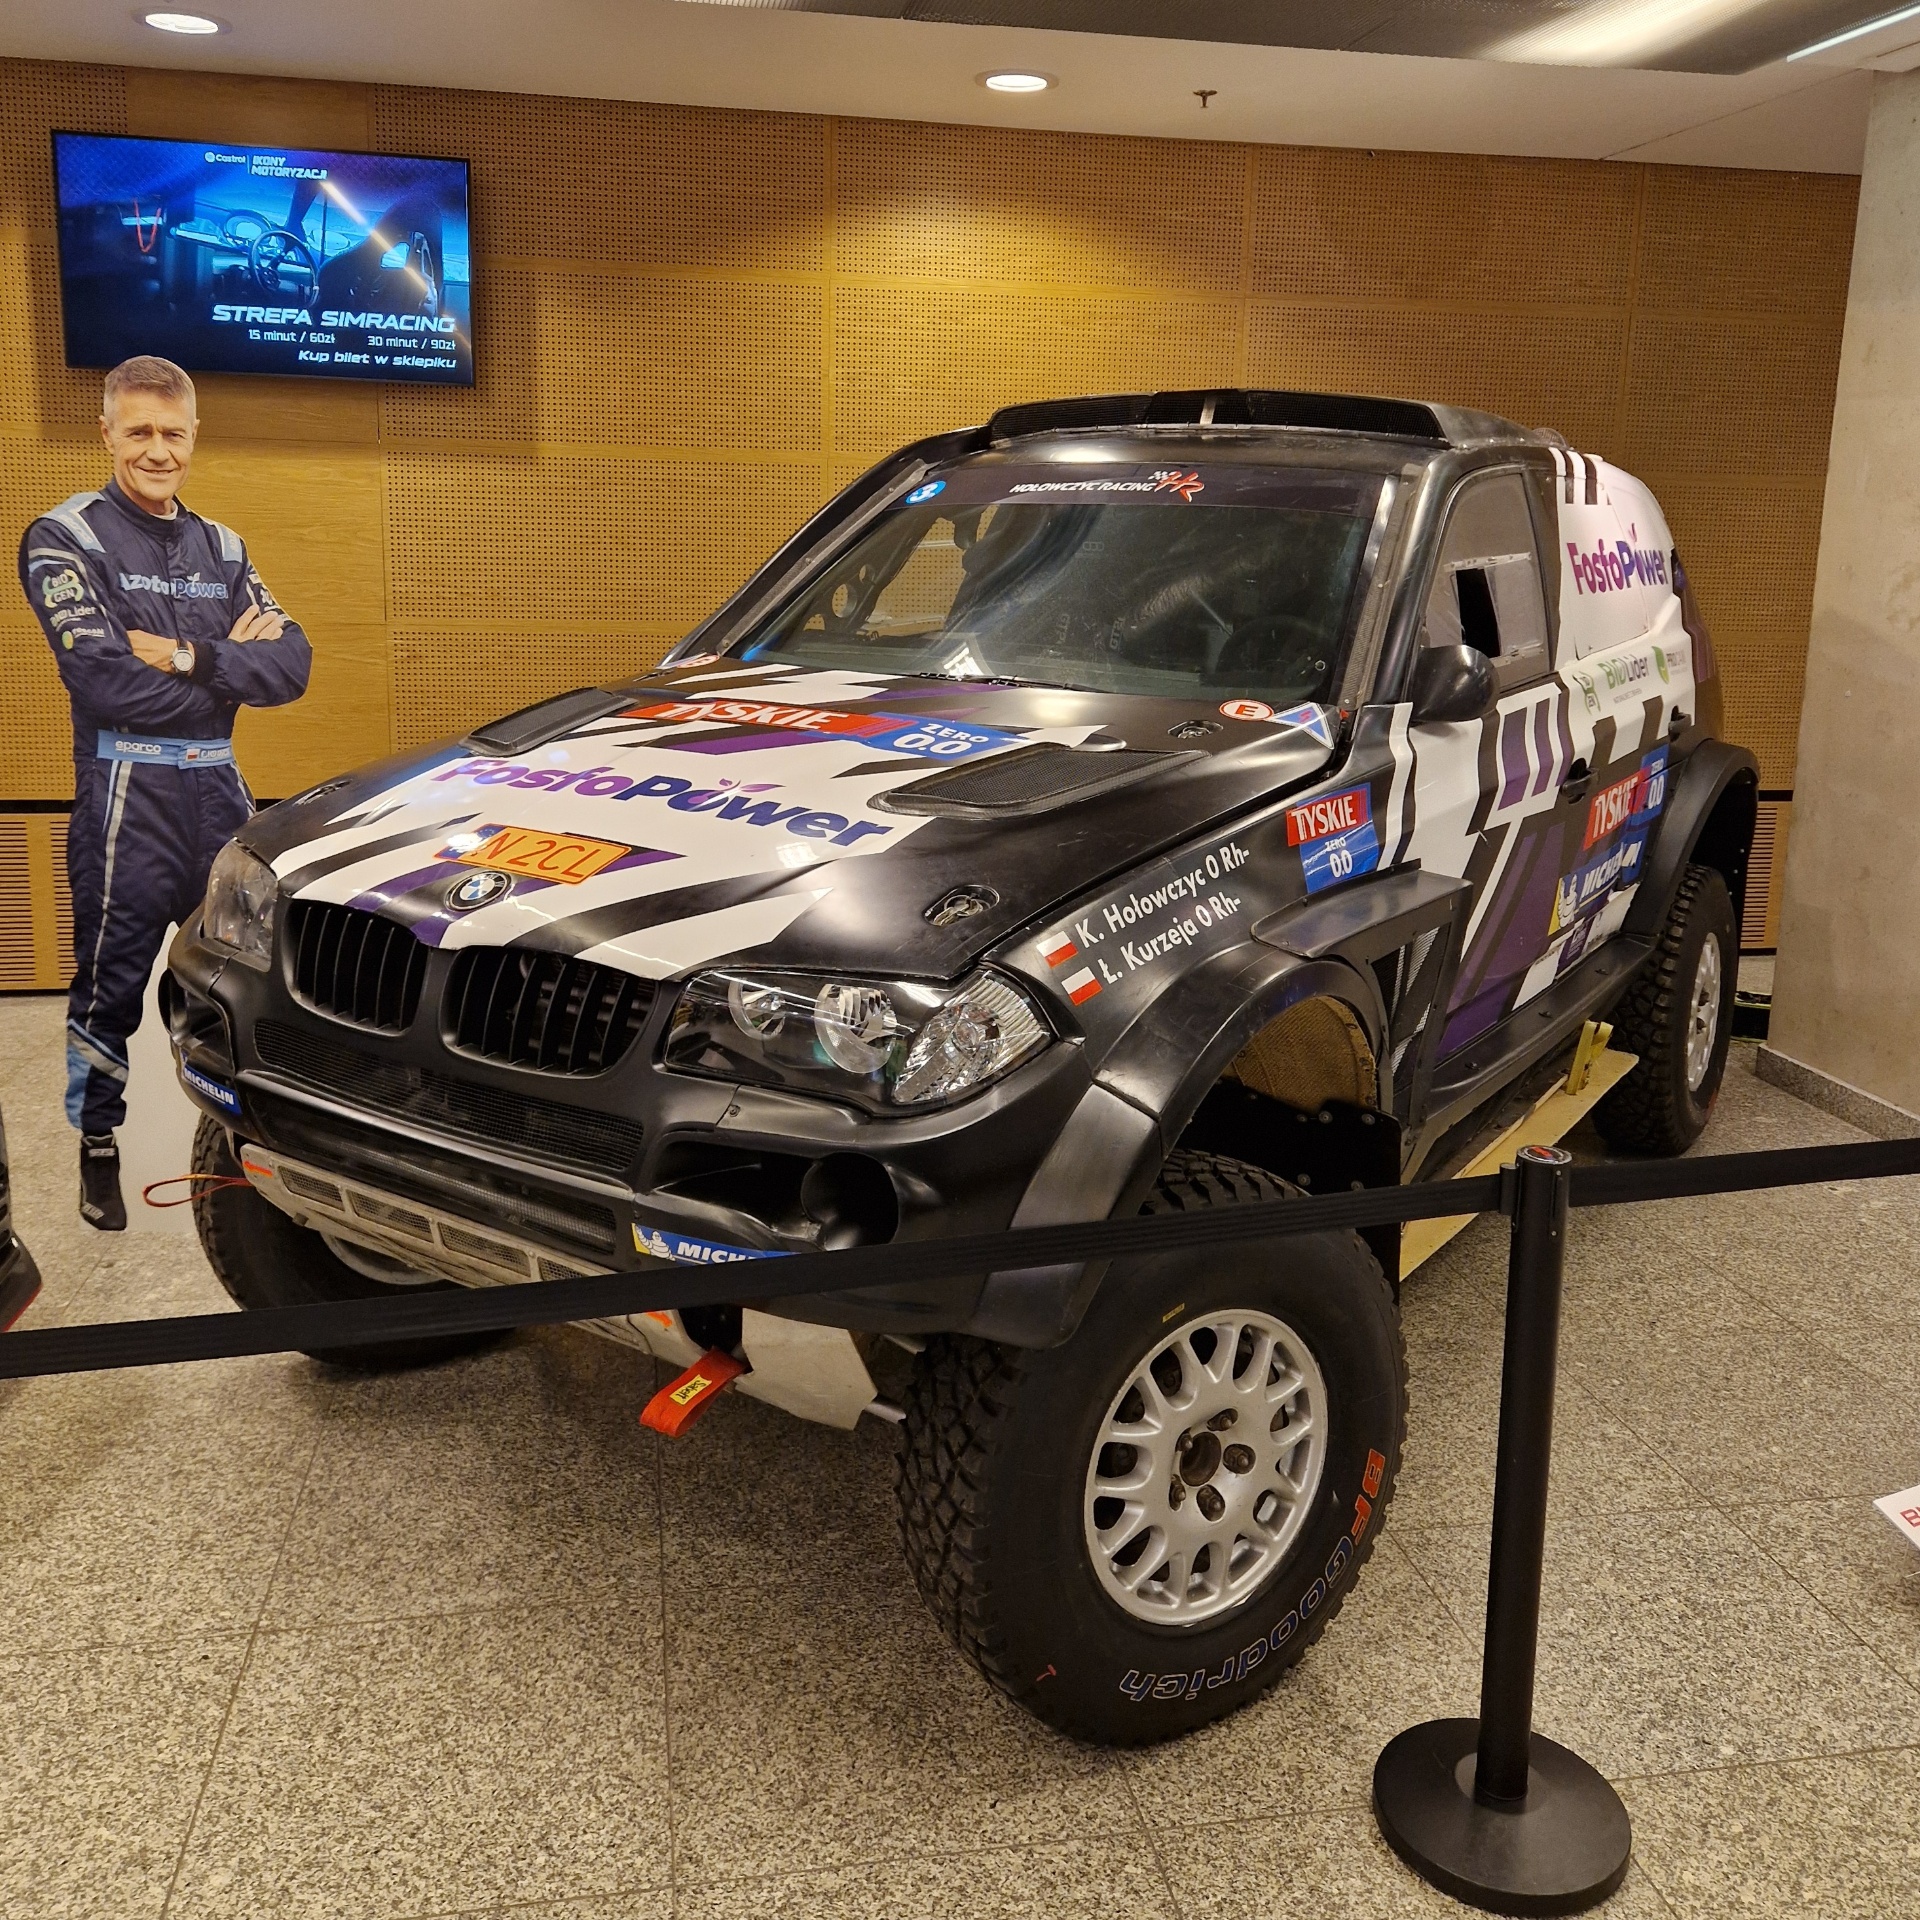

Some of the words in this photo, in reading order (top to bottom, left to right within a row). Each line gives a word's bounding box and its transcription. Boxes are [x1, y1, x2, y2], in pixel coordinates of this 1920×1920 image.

[216, 154, 246, 163] Castrol
[252, 155, 286, 166] IKONY
[251, 165, 328, 180] MOTORYZACJI
[212, 304, 312, 326] STREFA
[321, 311, 456, 333] SIMRACING
[248, 329, 260, 340] 15
[264, 330, 297, 342] minut
[299, 331, 306, 343] /
[310, 332, 335, 344] 60zł
[368, 336, 382, 347] 30
[386, 337, 418, 349] minut
[421, 338, 428, 350] /
[431, 340, 456, 351] 90zł
[299, 350, 329, 363] Kup
[334, 352, 370, 364] bilet
[375, 356, 388, 365] w
[393, 356, 457, 369] sklepiku
[1098, 482, 1158, 492] RACING
[1567, 538, 1669, 595] FosfoPower
[654, 701, 849, 731] TYSKIE
[894, 734, 973, 755] 0.0
[923, 723, 990, 744] ZERO
[431, 759, 895, 847] FosfoPower
[1592, 776, 1639, 838] TYSKIE
[1291, 795, 1357, 841] TYSKIE
[1325, 837, 1347, 852] ZERO
[1329, 849, 1353, 878] 0.0
[1075, 918, 1105, 949] K.
[1102, 868, 1207, 933] Hołowczyc
[1219, 842, 1250, 872] Rh-
[1098, 958, 1123, 985] Ł.
[1120, 917, 1200, 971] Kurzeja
[1208, 891, 1242, 920] Rh-
[184, 1067, 235, 1106] MICHELIN
